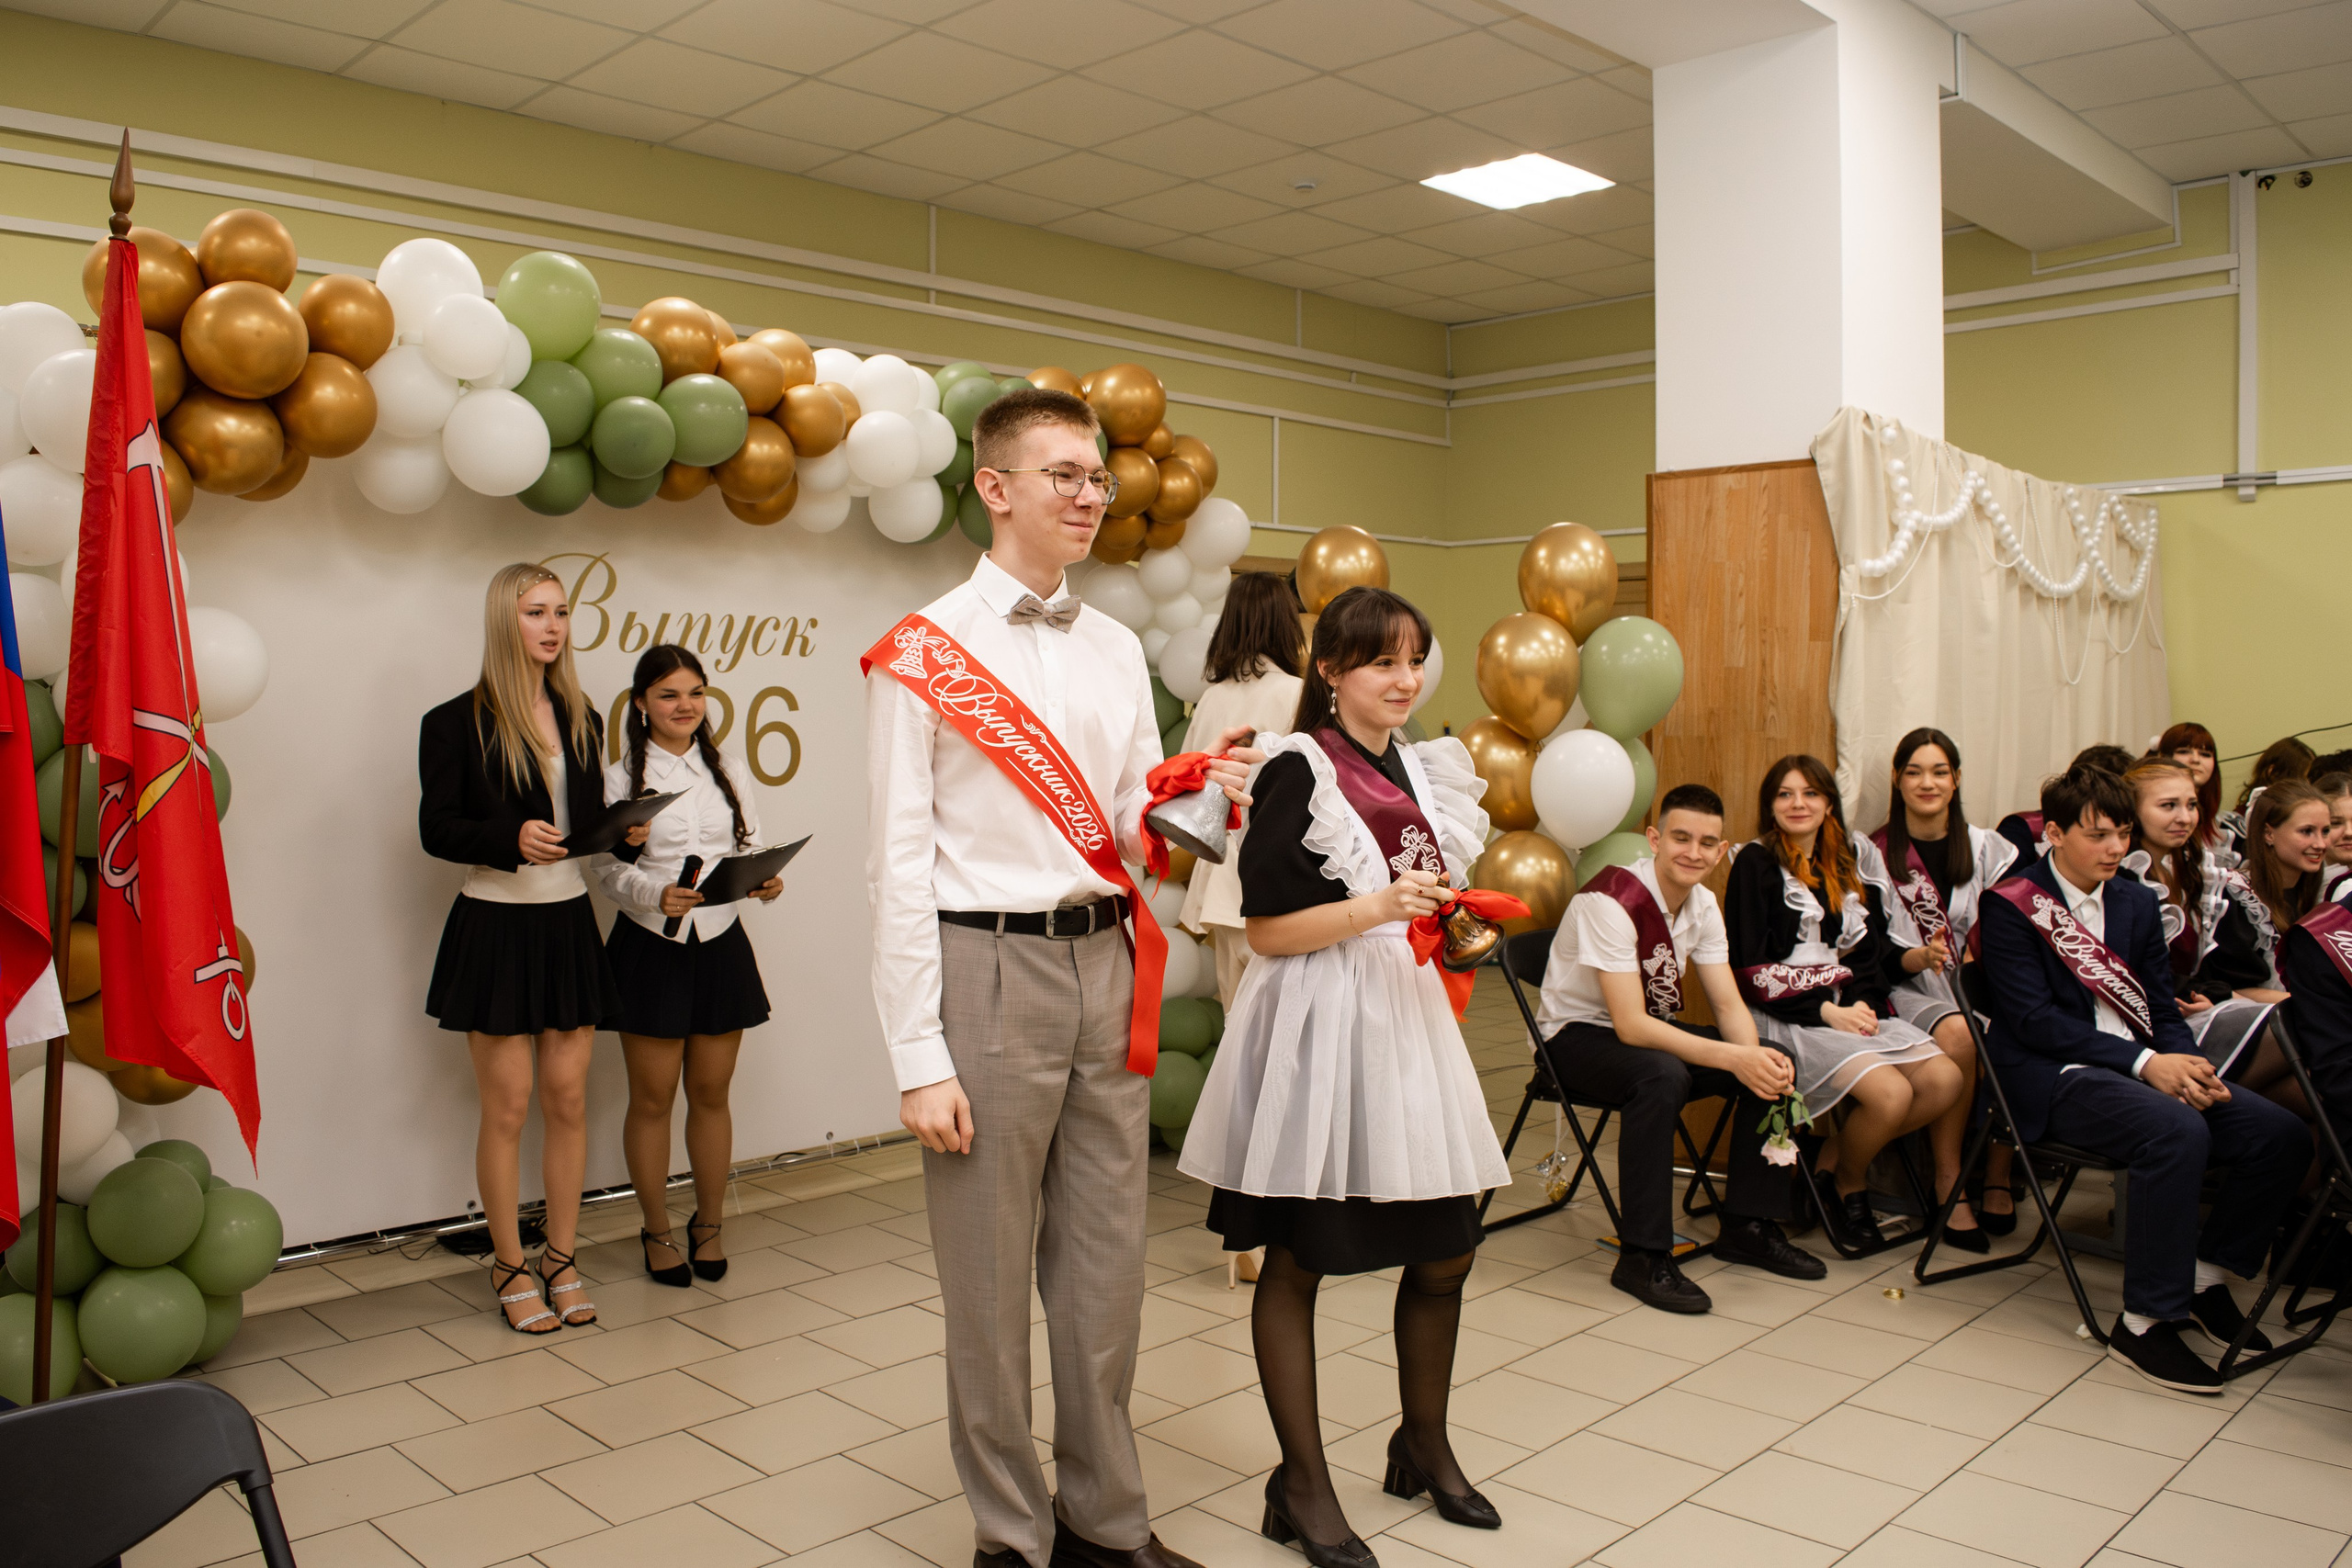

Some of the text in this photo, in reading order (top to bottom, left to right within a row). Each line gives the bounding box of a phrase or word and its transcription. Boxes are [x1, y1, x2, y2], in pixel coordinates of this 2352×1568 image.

[537, 551, 819, 673] Выпуск
[928, 669, 1109, 852] Выпускник 2026
